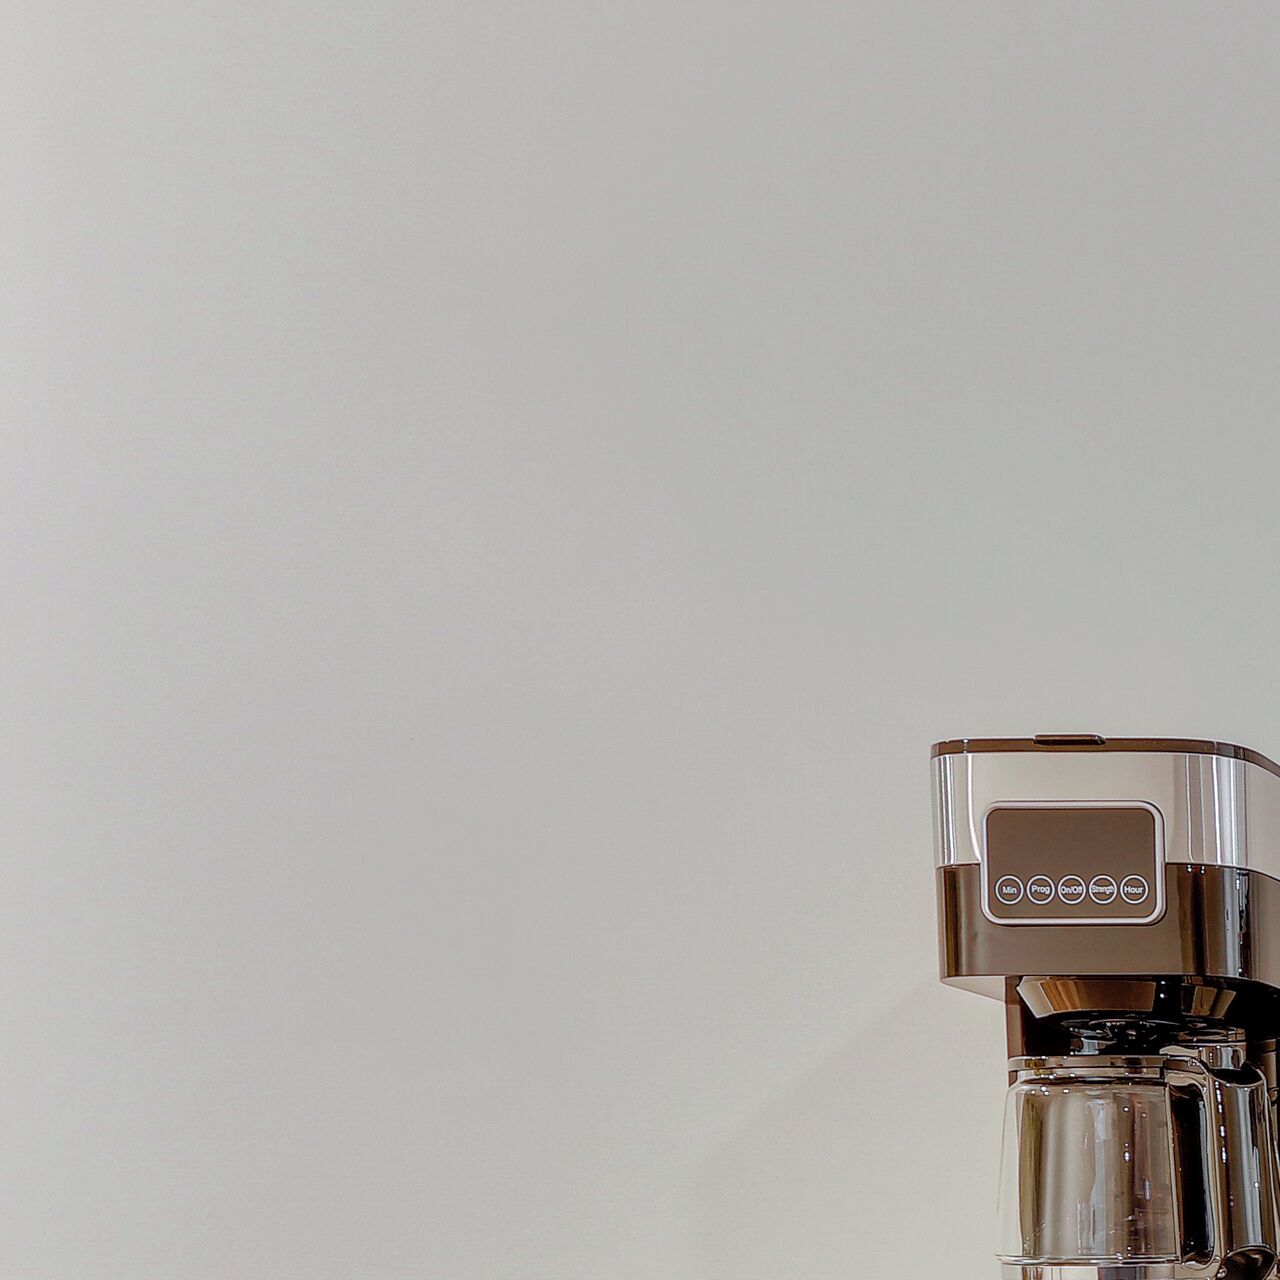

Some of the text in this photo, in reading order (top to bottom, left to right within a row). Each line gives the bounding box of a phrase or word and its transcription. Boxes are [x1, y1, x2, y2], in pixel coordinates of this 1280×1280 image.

[1002, 886, 1017, 894] Min
[1031, 884, 1050, 895] Prog
[1061, 885, 1083, 894] On/Off
[1124, 885, 1145, 894] Hour
